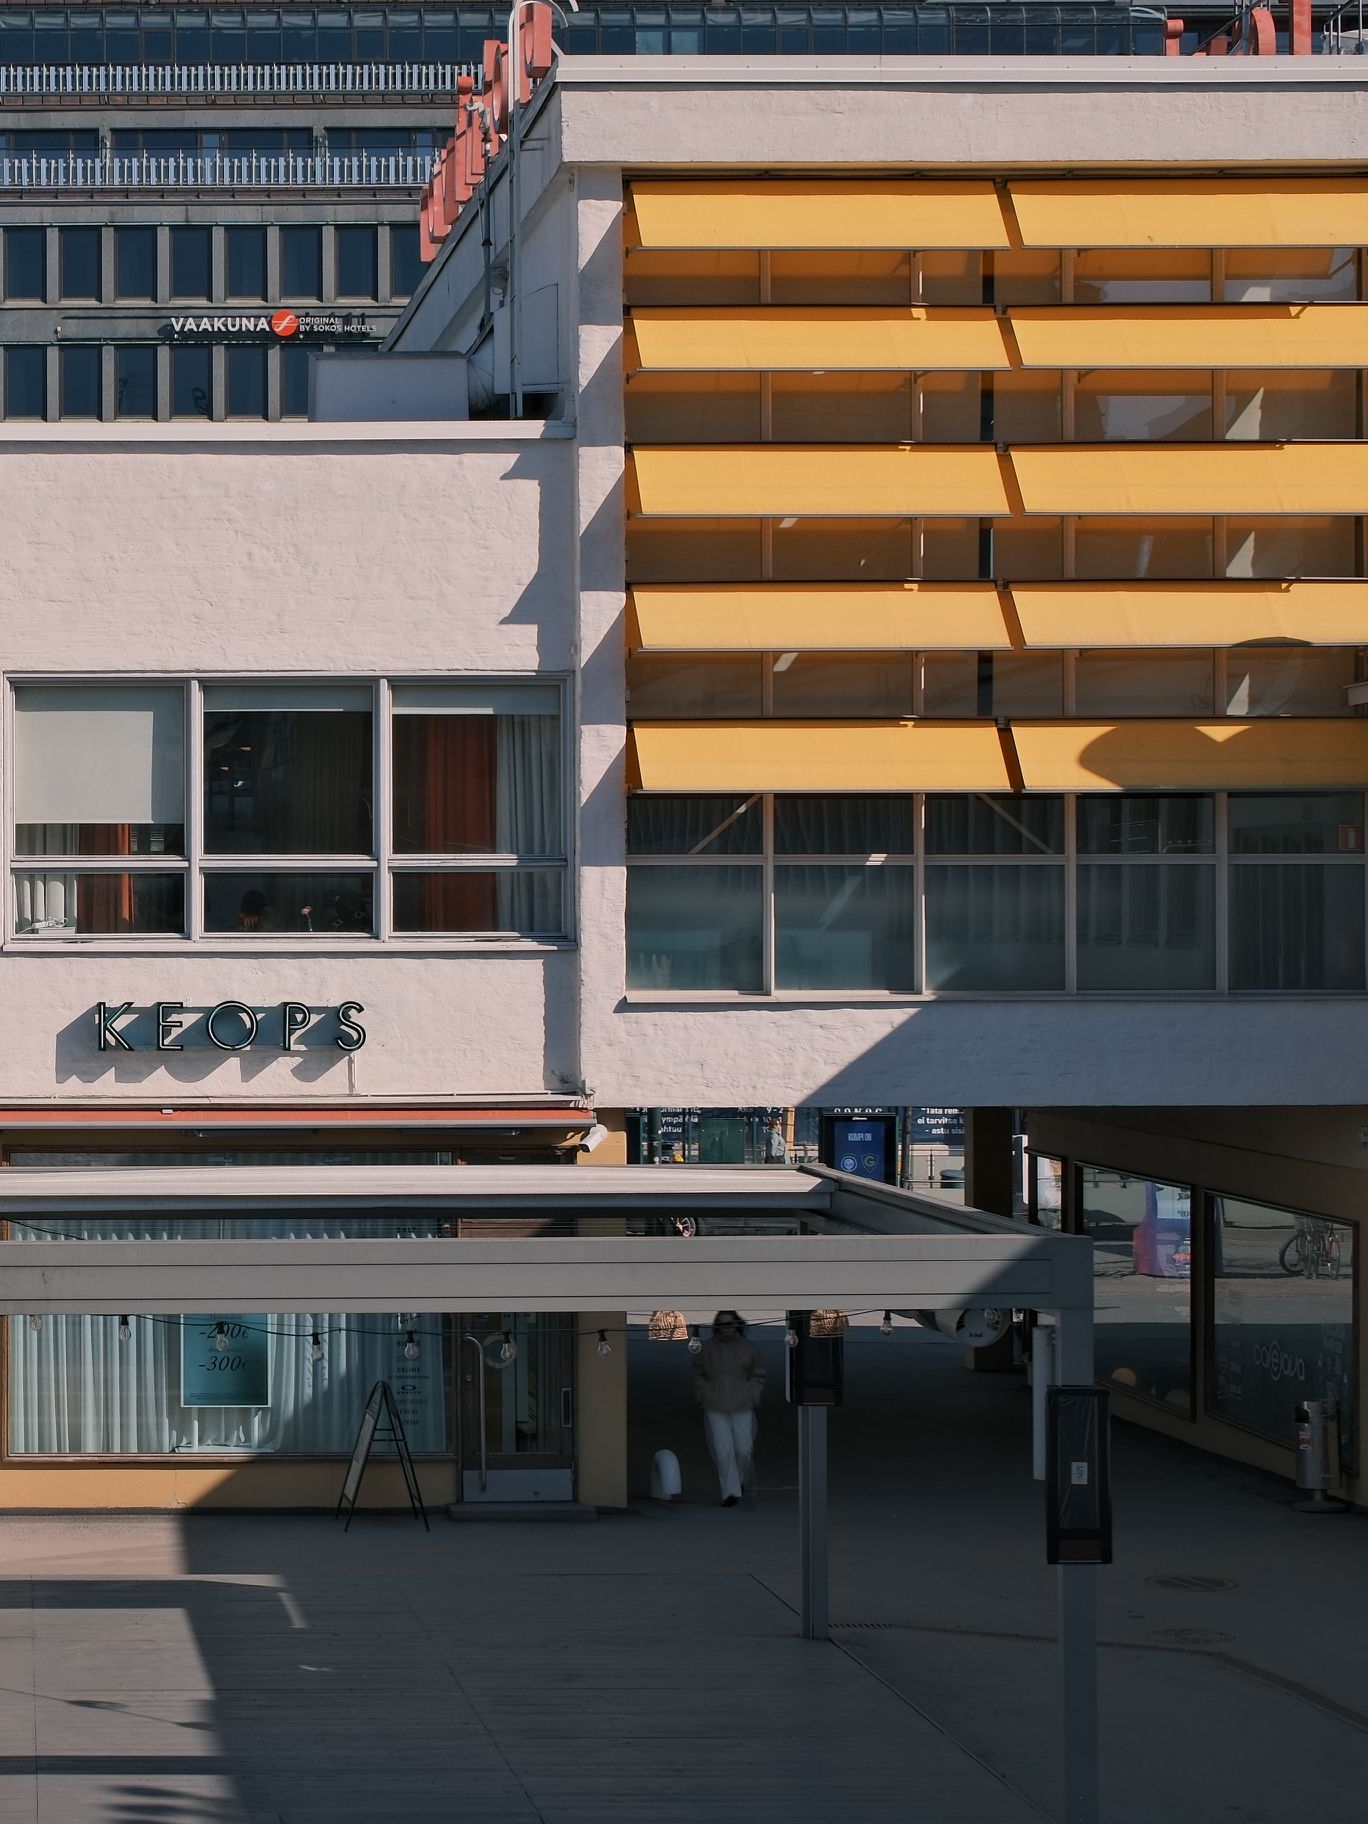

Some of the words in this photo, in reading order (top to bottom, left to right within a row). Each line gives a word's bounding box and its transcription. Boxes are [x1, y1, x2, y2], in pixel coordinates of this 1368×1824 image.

[171, 317, 270, 332] VAAKUNA
[299, 317, 340, 325] ORIGINAL
[97, 1000, 367, 1052] KEOPS
